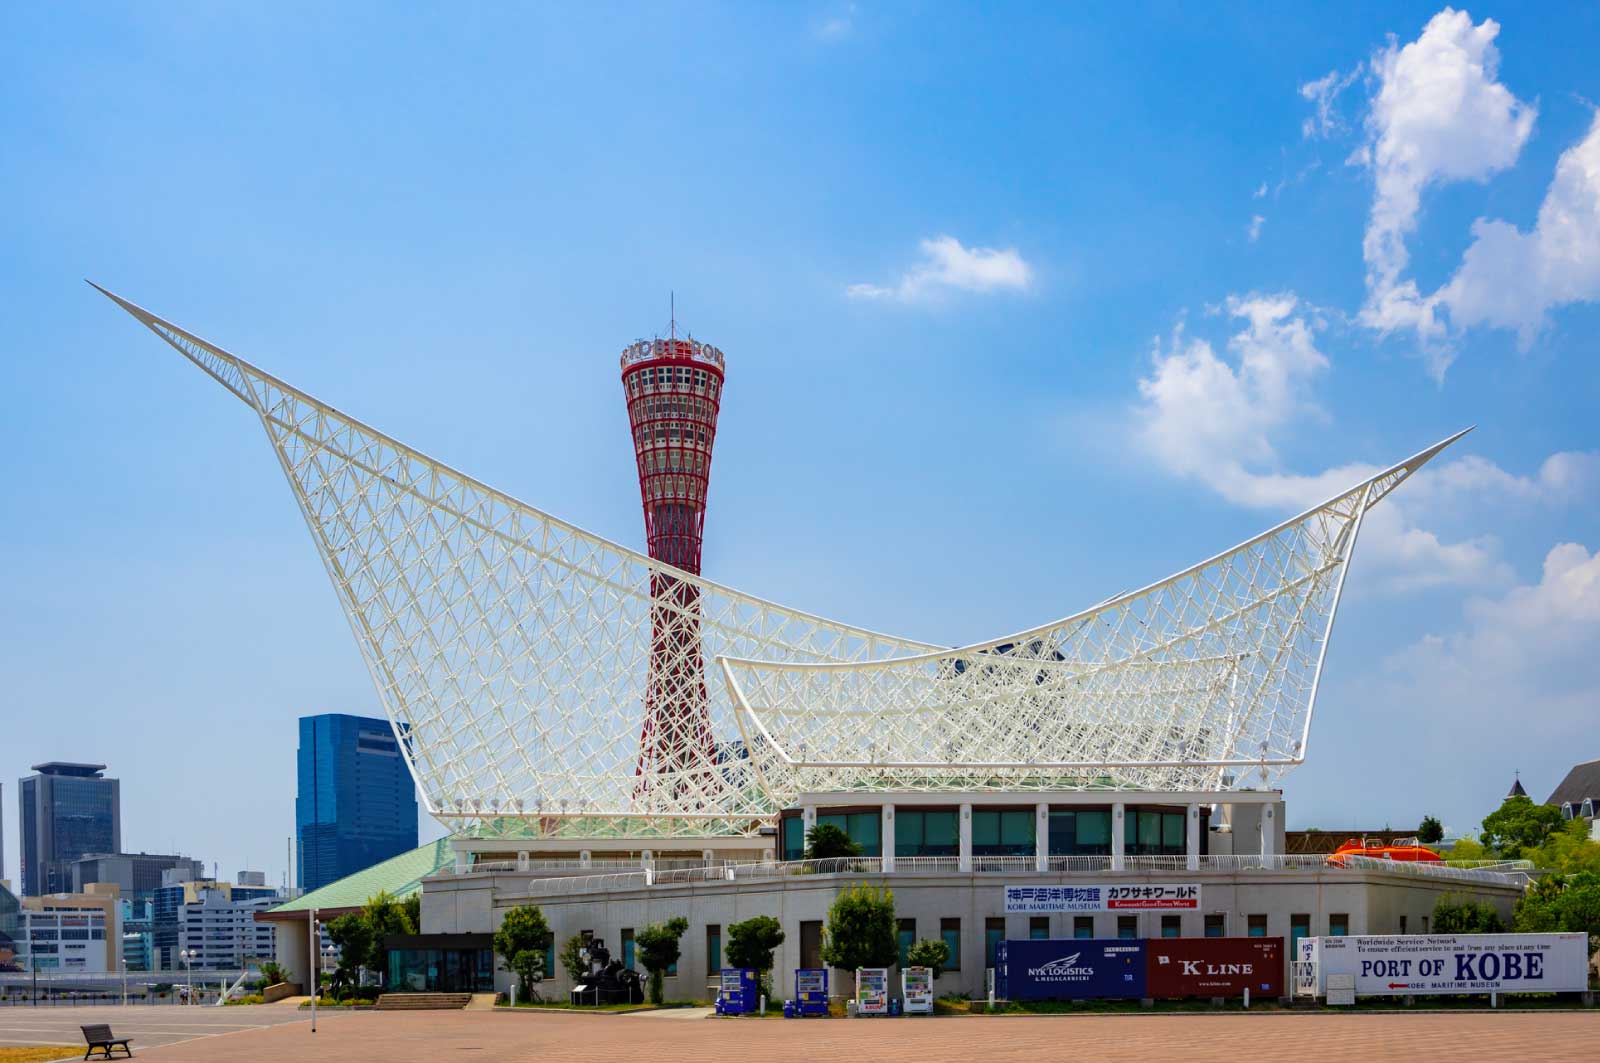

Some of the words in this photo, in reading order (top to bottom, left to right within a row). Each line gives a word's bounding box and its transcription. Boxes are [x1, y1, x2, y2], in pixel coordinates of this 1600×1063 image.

[1008, 888, 1100, 902] 神戸海洋博物館
[1108, 886, 1197, 899] カワサキワールド
[1028, 968, 1046, 976] NYK
[1049, 967, 1094, 976] LOGISTICS
[1207, 964, 1253, 975] LINE
[1361, 960, 1412, 977] PORT
[1419, 959, 1445, 976] OF
[1454, 953, 1543, 980] KOBE
